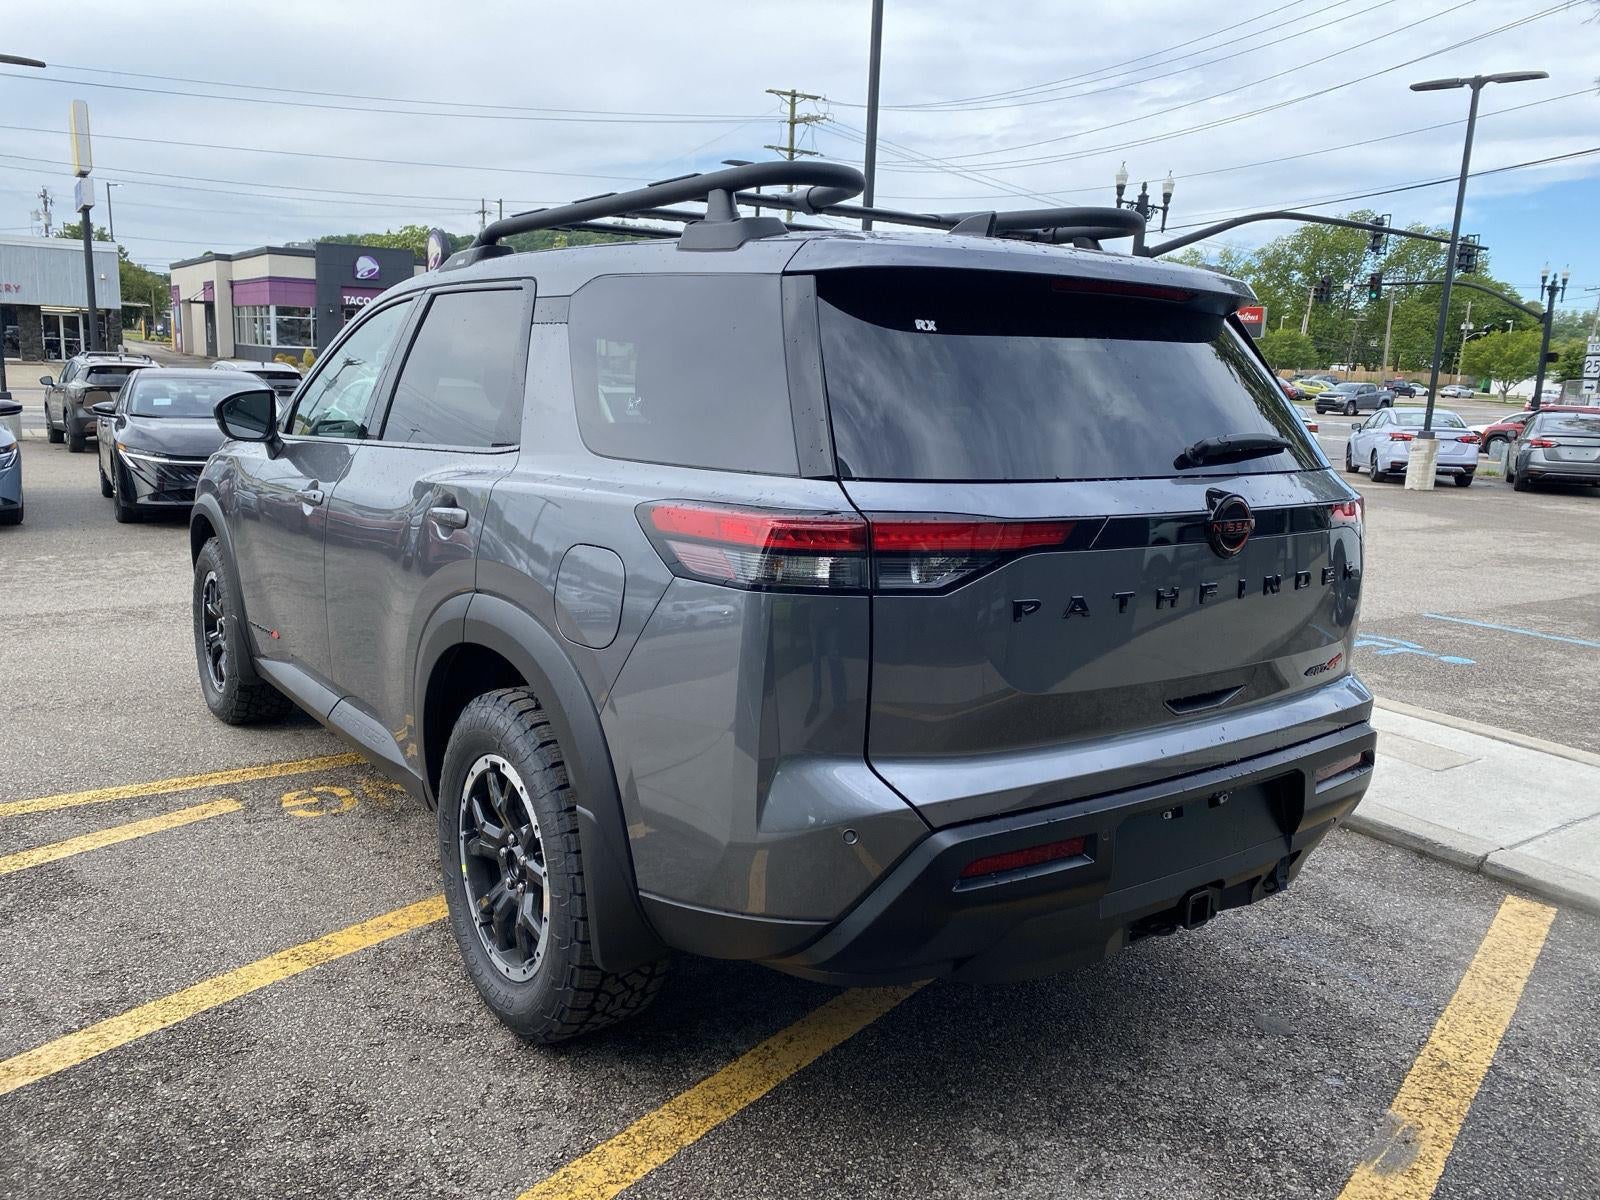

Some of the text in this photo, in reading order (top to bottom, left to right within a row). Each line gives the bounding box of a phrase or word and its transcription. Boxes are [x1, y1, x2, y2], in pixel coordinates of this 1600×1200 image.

[0, 283, 21, 293] RY
[343, 295, 372, 305] TACO
[1585, 360, 1600, 373] 25
[1012, 560, 1354, 622] PATHFINDER
